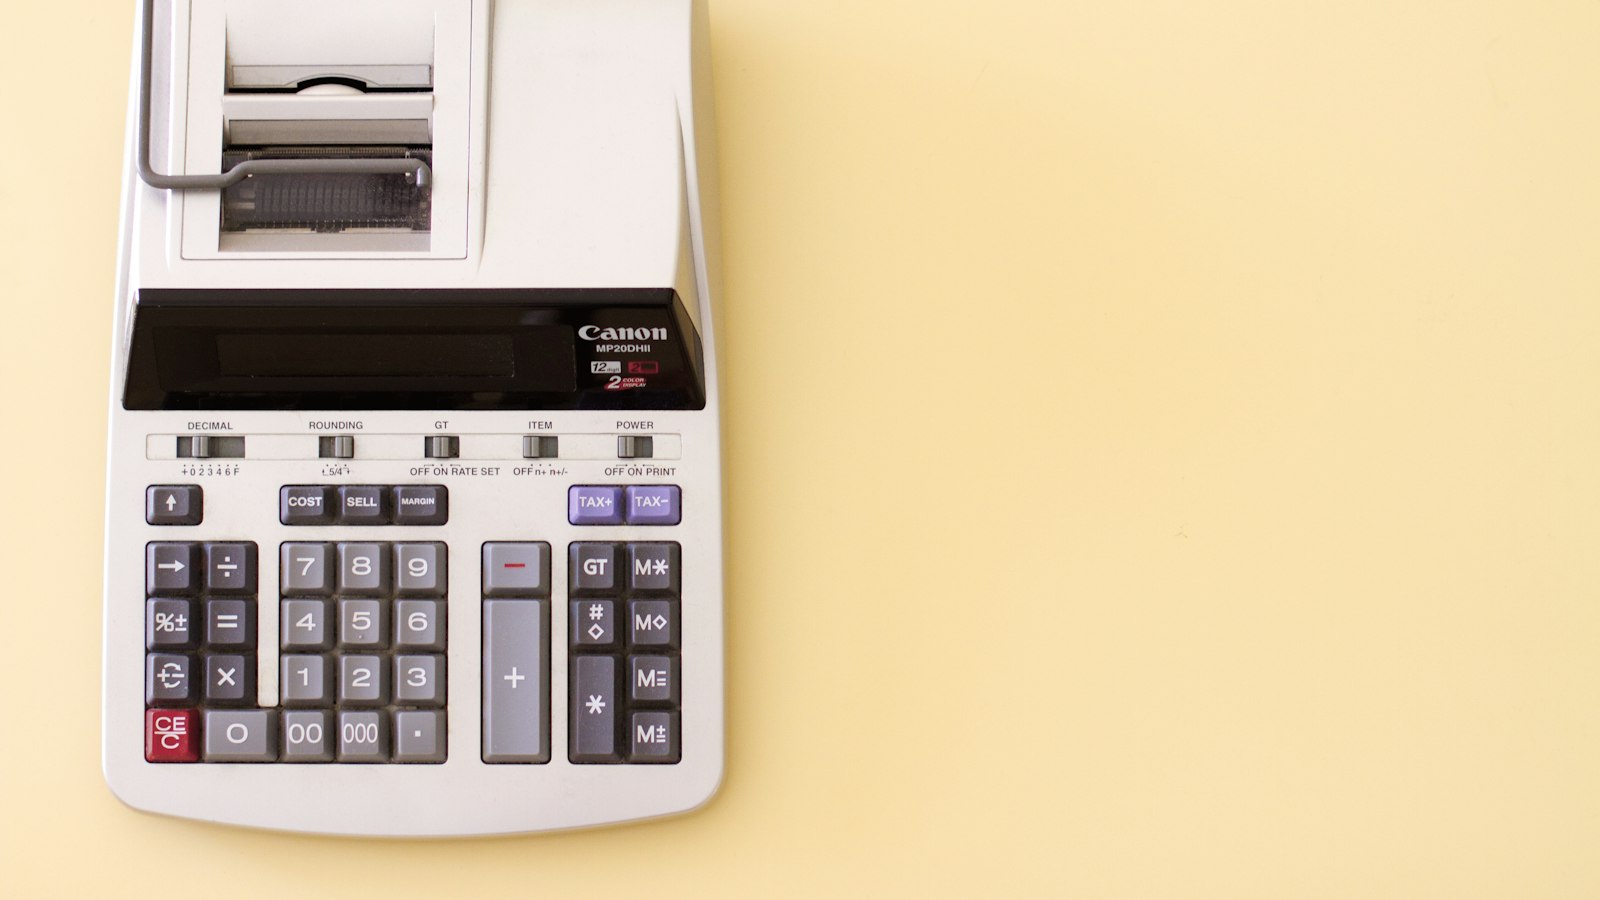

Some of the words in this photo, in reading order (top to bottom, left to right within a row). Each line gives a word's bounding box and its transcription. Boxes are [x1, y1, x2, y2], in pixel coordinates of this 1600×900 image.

[578, 325, 667, 340] Canon
[596, 344, 651, 353] MP20DHII
[593, 362, 606, 372] 12
[608, 375, 622, 389] 2
[187, 421, 233, 431] DECIMAL
[308, 421, 363, 430] ROUNDING
[434, 421, 449, 430] GT
[528, 421, 553, 430] ITEM
[616, 421, 654, 430] POWER
[410, 467, 430, 476] OFF
[433, 467, 448, 476] ON
[451, 467, 477, 476] RATE
[480, 467, 501, 476] SET
[513, 467, 533, 476] OFF
[604, 467, 624, 477] OFF
[627, 467, 643, 477] ON
[646, 467, 677, 477] PRINT
[288, 496, 322, 507] COST
[346, 496, 378, 507] SELL
[401, 497, 435, 505] MARGIN
[579, 496, 613, 508] TAX+
[296, 557, 316, 576] 7
[351, 557, 372, 576] 8
[407, 558, 428, 577] 9
[583, 558, 608, 576] GT
[295, 613, 316, 631] 4
[352, 611, 371, 630] 5
[407, 612, 428, 631] 6
[297, 667, 309, 686] 1
[352, 668, 370, 687] 2
[407, 667, 427, 686] 3
[155, 717, 186, 731] CE
[226, 723, 248, 744] 0
[288, 723, 322, 744] 00
[343, 723, 378, 744] 000
[161, 735, 180, 749] C
